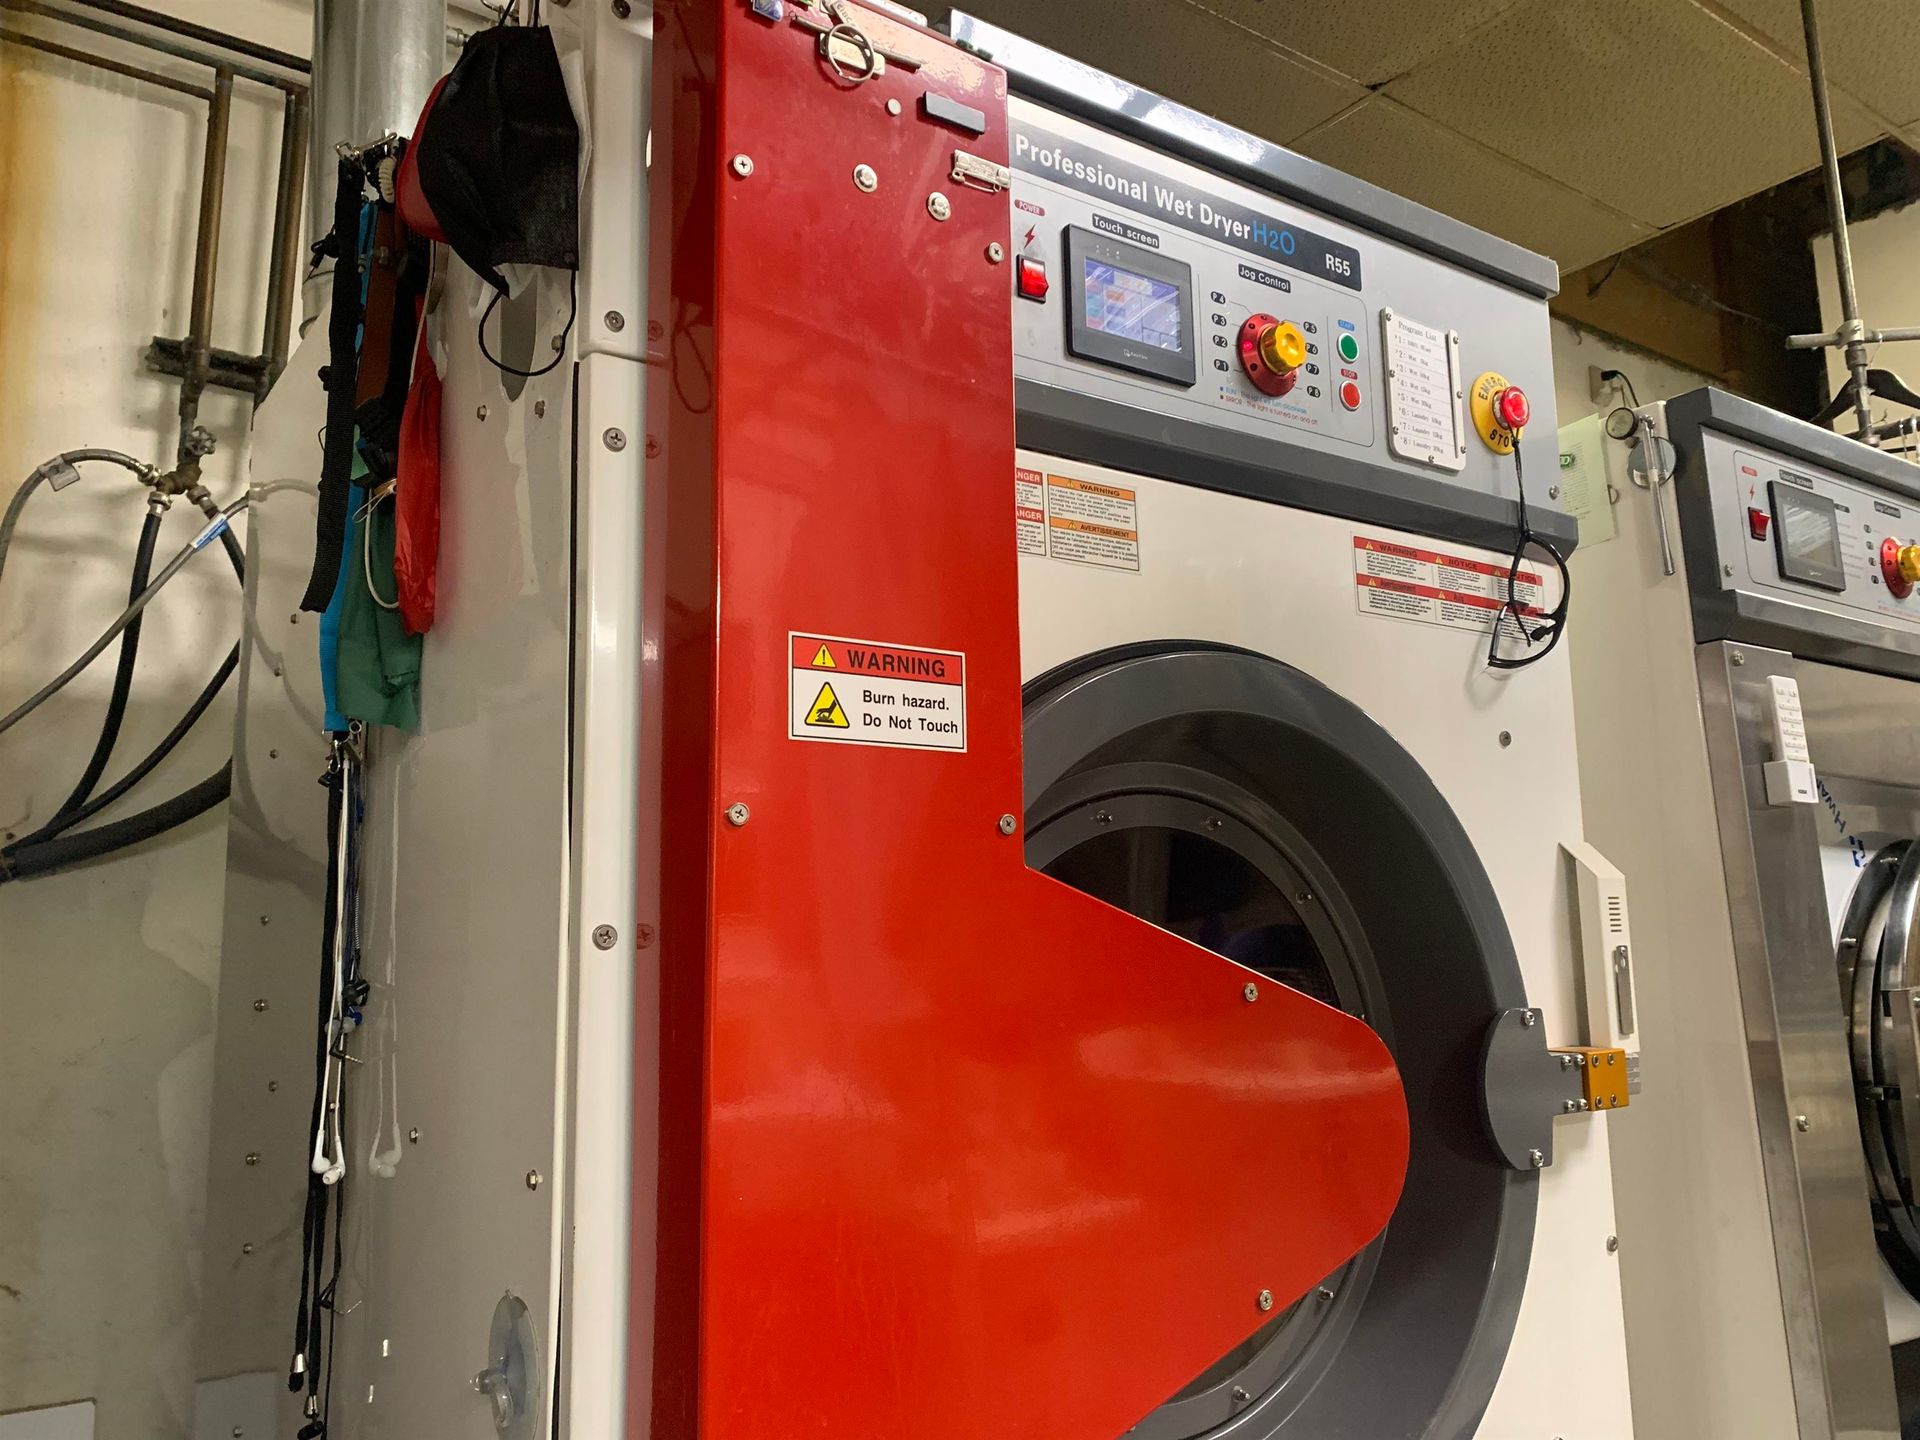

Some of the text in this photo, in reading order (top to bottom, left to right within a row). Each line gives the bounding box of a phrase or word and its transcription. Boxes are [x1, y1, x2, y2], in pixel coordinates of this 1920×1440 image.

[1015, 133, 1351, 276] Professional Wet Dryer H2O R55
[1018, 200, 1041, 214] POWER
[1093, 215, 1159, 247] Touch screen
[1239, 266, 1289, 292] Jog Control
[1399, 321, 1436, 341] Program List
[1342, 369, 1357, 380] STOP
[1079, 483, 1120, 497] WARNING
[1080, 524, 1130, 538] AVERTISSEMENT
[1379, 544, 1417, 557] WARNING
[1448, 559, 1478, 571] NOTICE
[847, 649, 945, 678] WARNING
[863, 690, 949, 711] Burn hazard.
[863, 713, 958, 733] Do Not Touch
